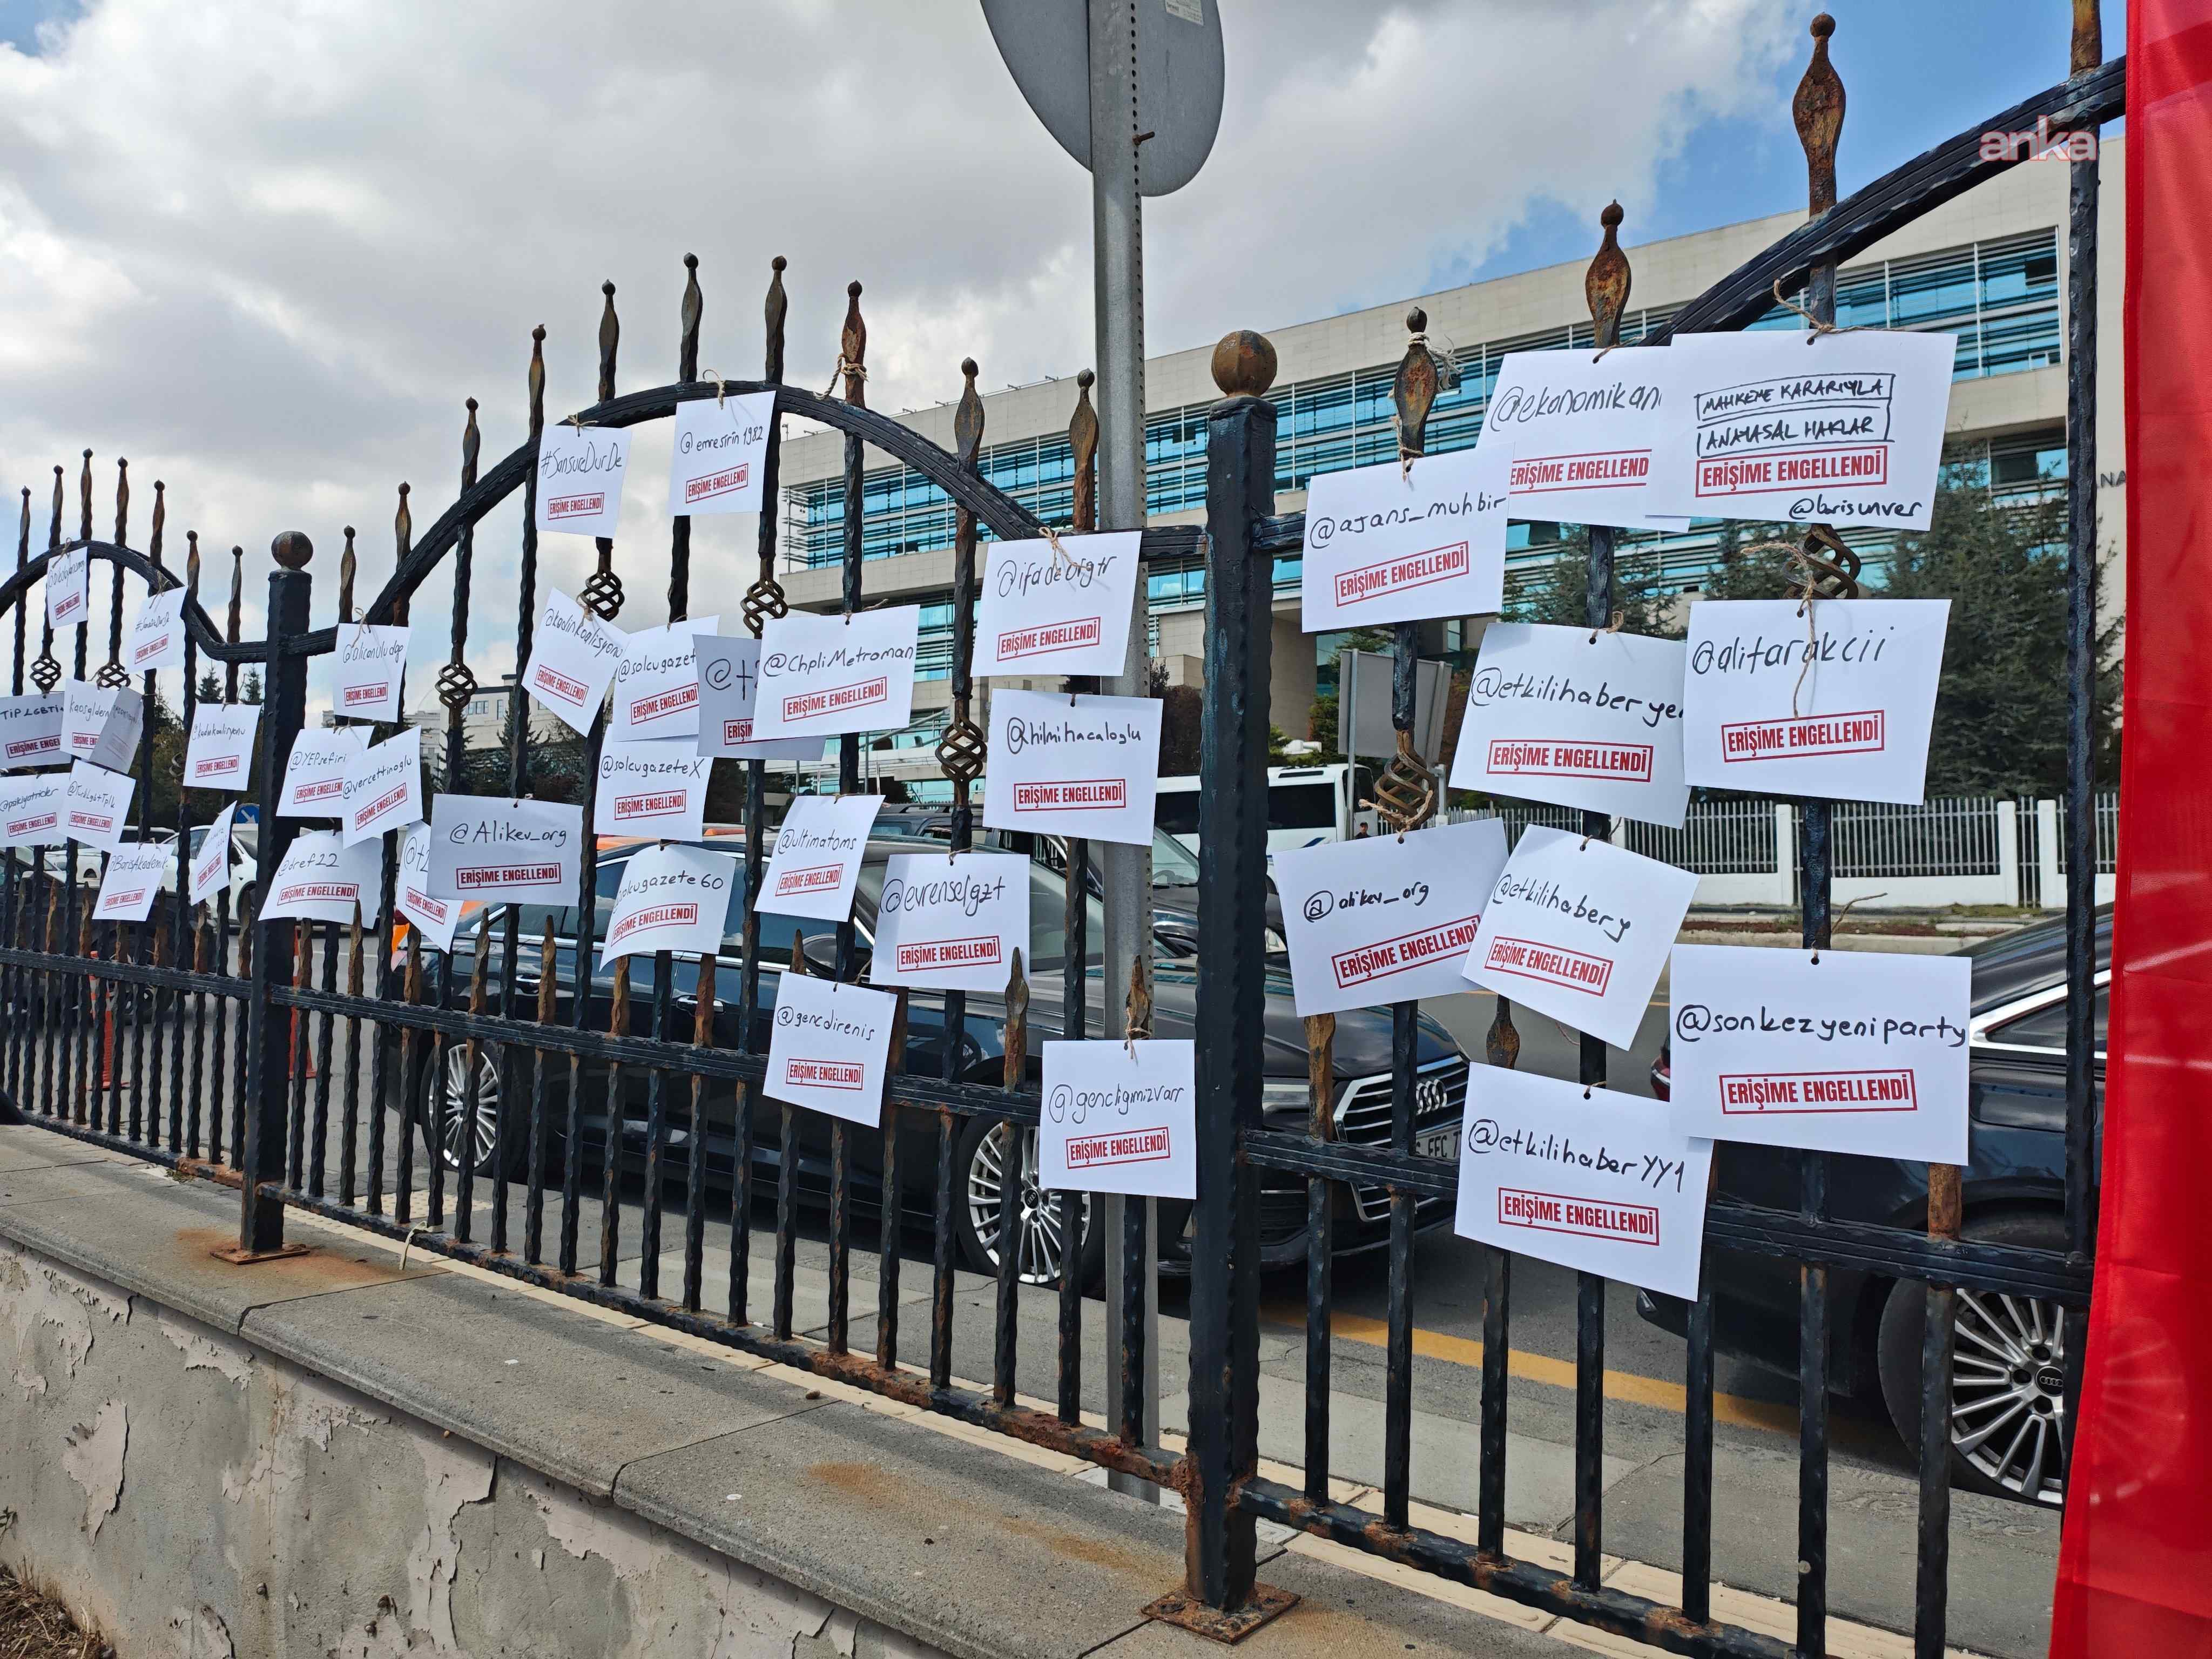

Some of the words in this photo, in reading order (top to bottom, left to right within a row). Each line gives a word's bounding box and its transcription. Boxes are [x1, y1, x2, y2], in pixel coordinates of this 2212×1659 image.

[1491, 382, 1662, 432] @ekonomikan
[1703, 388, 1774, 414] MAHKEME
[1781, 379, 1883, 404] KARARIYLA
[1708, 420, 1799, 449] ANAYASAL
[1805, 416, 1874, 439] HAKLAR
[688, 479, 711, 498] ERİŞİME
[713, 467, 746, 490] ENGELLENDİ
[1510, 462, 1564, 489] ERİŞİME
[1567, 457, 1649, 481] ENGELLEND
[1703, 461, 1771, 491] ERİŞİME
[1778, 450, 1881, 480] ENGELLENDİ
[2100, 470, 2126, 488] NA
[550, 498, 569, 517] ERİŞİME
[570, 495, 603, 511] ENGELLENDİ
[1789, 494, 1922, 520] @barisunver
[1340, 573, 1388, 598] ERİŞİME
[1391, 547, 1464, 582] ENGELLENDİ
[1001, 634, 1036, 656] ERİŞİME
[1039, 623, 1096, 646] ENGELLENDİ
[618, 649, 696, 683] @solcugazet
[706, 658, 759, 700] @t
[346, 689, 362, 705] ERİŞİME
[363, 684, 387, 699] ENGELLENDİ
[537, 667, 555, 689] ERİŞİME
[556, 679, 586, 701] ENGELLENDİ
[787, 697, 826, 716] ERİŞİME
[830, 680, 884, 706] ENGELLENDİ
[1472, 667, 1683, 727] @etkilihaberye
[633, 699, 659, 719] ERİŞİME
[660, 686, 698, 709] ENGELLENDİ
[9, 739, 38, 756] ERİŞİME
[41, 738, 60, 749] ENGEL
[1007, 717, 1141, 754] @hilmihacaloglu
[1728, 726, 1784, 757] ERİŞİME
[1789, 714, 1878, 747] ENGELLENDİ
[601, 755, 704, 779] @solcugazeteX
[1493, 744, 1550, 771] ERİŞİME
[1554, 747, 1647, 772] ENGELLENDİ
[296, 785, 316, 800] ERİŞİME
[342, 755, 412, 800] @vercettinoglu
[358, 807, 376, 825] ERİŞİME
[377, 787, 406, 812] ENGELLENDİ
[617, 799, 644, 817] ERİŞİME
[645, 792, 684, 809] ENGELLENDİ
[1019, 787, 1060, 808] ERİŞİME
[1062, 783, 1123, 802] ENGELLENDİ
[404, 837, 430, 872] @t2
[778, 829, 858, 854] @ultimatoms
[280, 887, 306, 900] ERİŞİME
[307, 885, 356, 898] ENGELLENDİ
[461, 872, 500, 890] ERİŞİME
[503, 866, 558, 882] ENGELLENDİ
[779, 874, 804, 893] ERİŞİME
[804, 866, 841, 886] ENGELLENDİ
[408, 891, 422, 908] ERİŞİME
[422, 900, 446, 919] ENGELLENDİ
[1492, 874, 1632, 943] @etkilihabery
[613, 917, 637, 940] ERİŞİME
[638, 906, 694, 926] ENGELLENDİ
[901, 947, 937, 968] ERİŞİME
[940, 940, 997, 961] ENGELLENDİ
[1340, 949, 1397, 980] ERİŞİME
[1401, 920, 1478, 961] ENGELLENDİ
[1491, 943, 1526, 968] ERİŞİME
[1527, 950, 1606, 986] ENGELLENDİ
[777, 1006, 875, 1041] @gencdirenis
[1676, 1004, 1966, 1049] @sonkezyeniparty
[789, 1062, 818, 1083] ERİŞİME
[818, 1063, 861, 1084] ENGELLENDİ
[1728, 1078, 1798, 1110] ERİŞİME
[1803, 1074, 1910, 1102] ENGELLENDİ
[1070, 1139, 1108, 1164] ERİŞİME
[1110, 1130, 1166, 1157] ENGELLENDİ
[1453, 1131, 1460, 1158] 7
[1504, 1195, 1562, 1224] ERİŞİME
[1566, 1203, 1653, 1236] ENGELLENDİ
